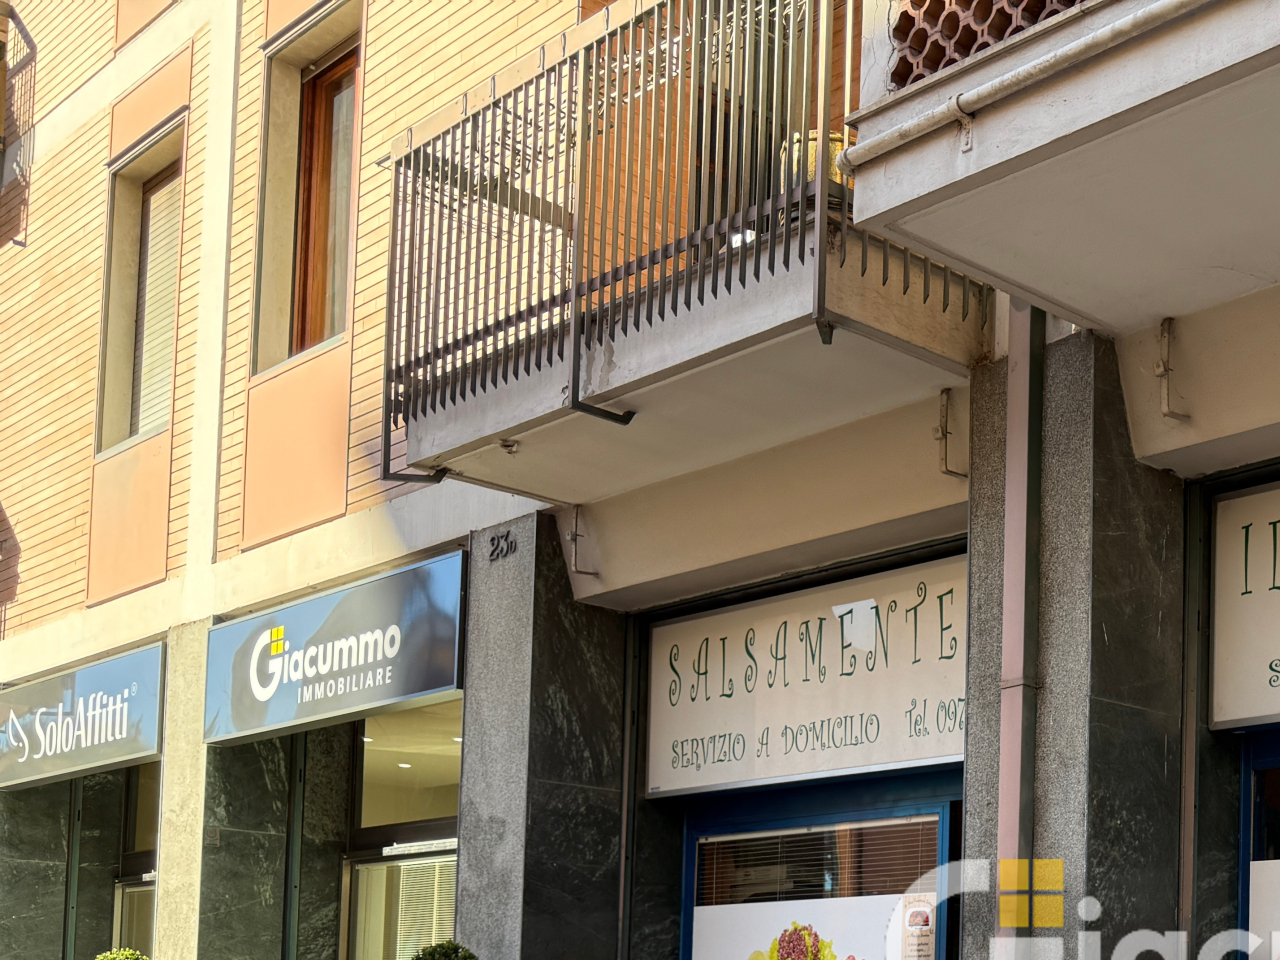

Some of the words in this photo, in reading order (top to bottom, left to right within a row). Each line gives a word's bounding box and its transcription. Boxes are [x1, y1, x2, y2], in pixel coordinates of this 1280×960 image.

[249, 625, 401, 702] Giacummo
[668, 581, 958, 707] SALSAMENTE
[297, 665, 392, 704] IMMOBILIARE
[33, 688, 129, 759] SoloAffitti
[671, 733, 746, 771] SERVIZIO
[756, 726, 770, 758] A
[781, 713, 880, 755] DOMICILIO
[905, 698, 930, 738] Tel.
